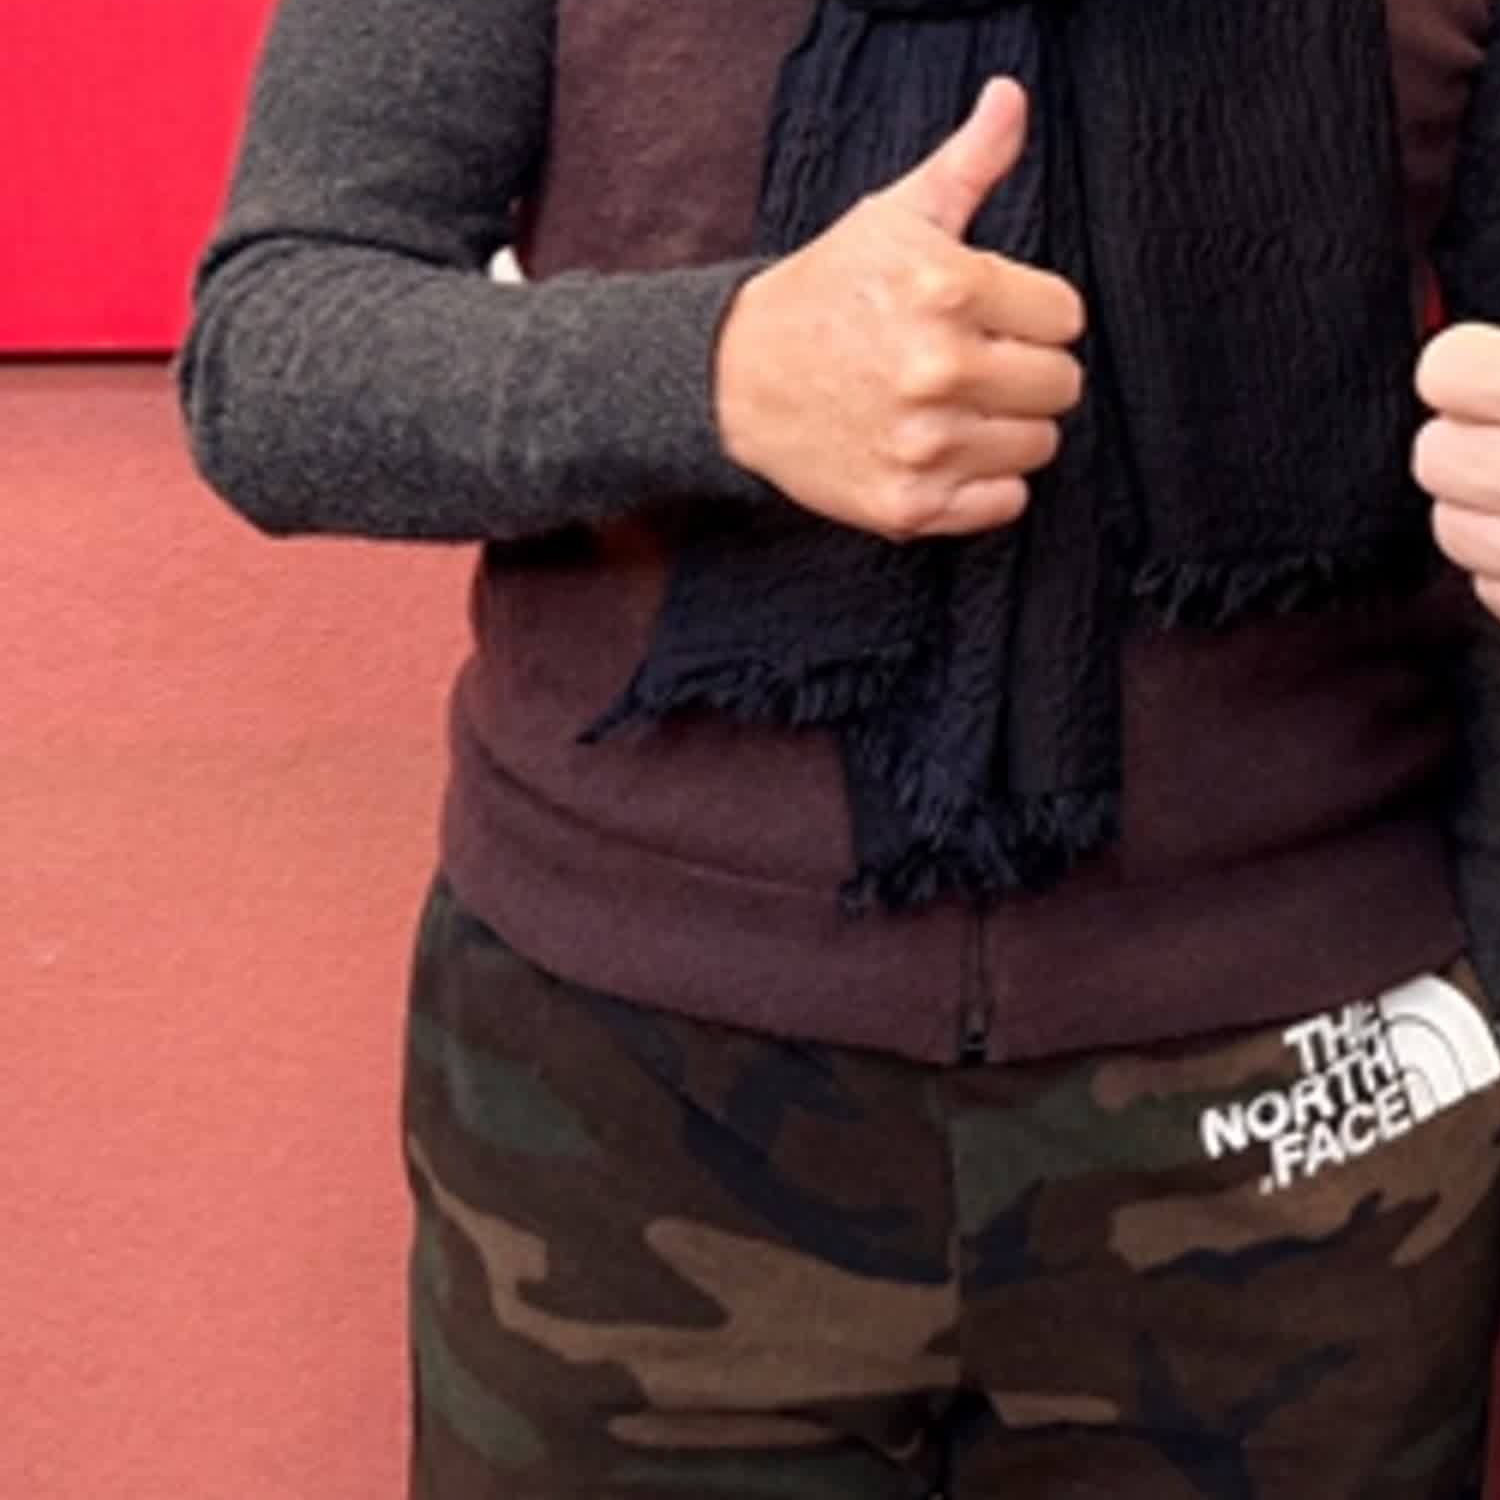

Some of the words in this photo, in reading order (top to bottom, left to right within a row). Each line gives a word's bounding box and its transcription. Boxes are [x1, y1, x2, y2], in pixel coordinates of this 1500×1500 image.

[1283, 1003, 1384, 1074] THE
[1201, 1038, 1398, 1159] NORTH
[1271, 1084, 1413, 1189] FACE
